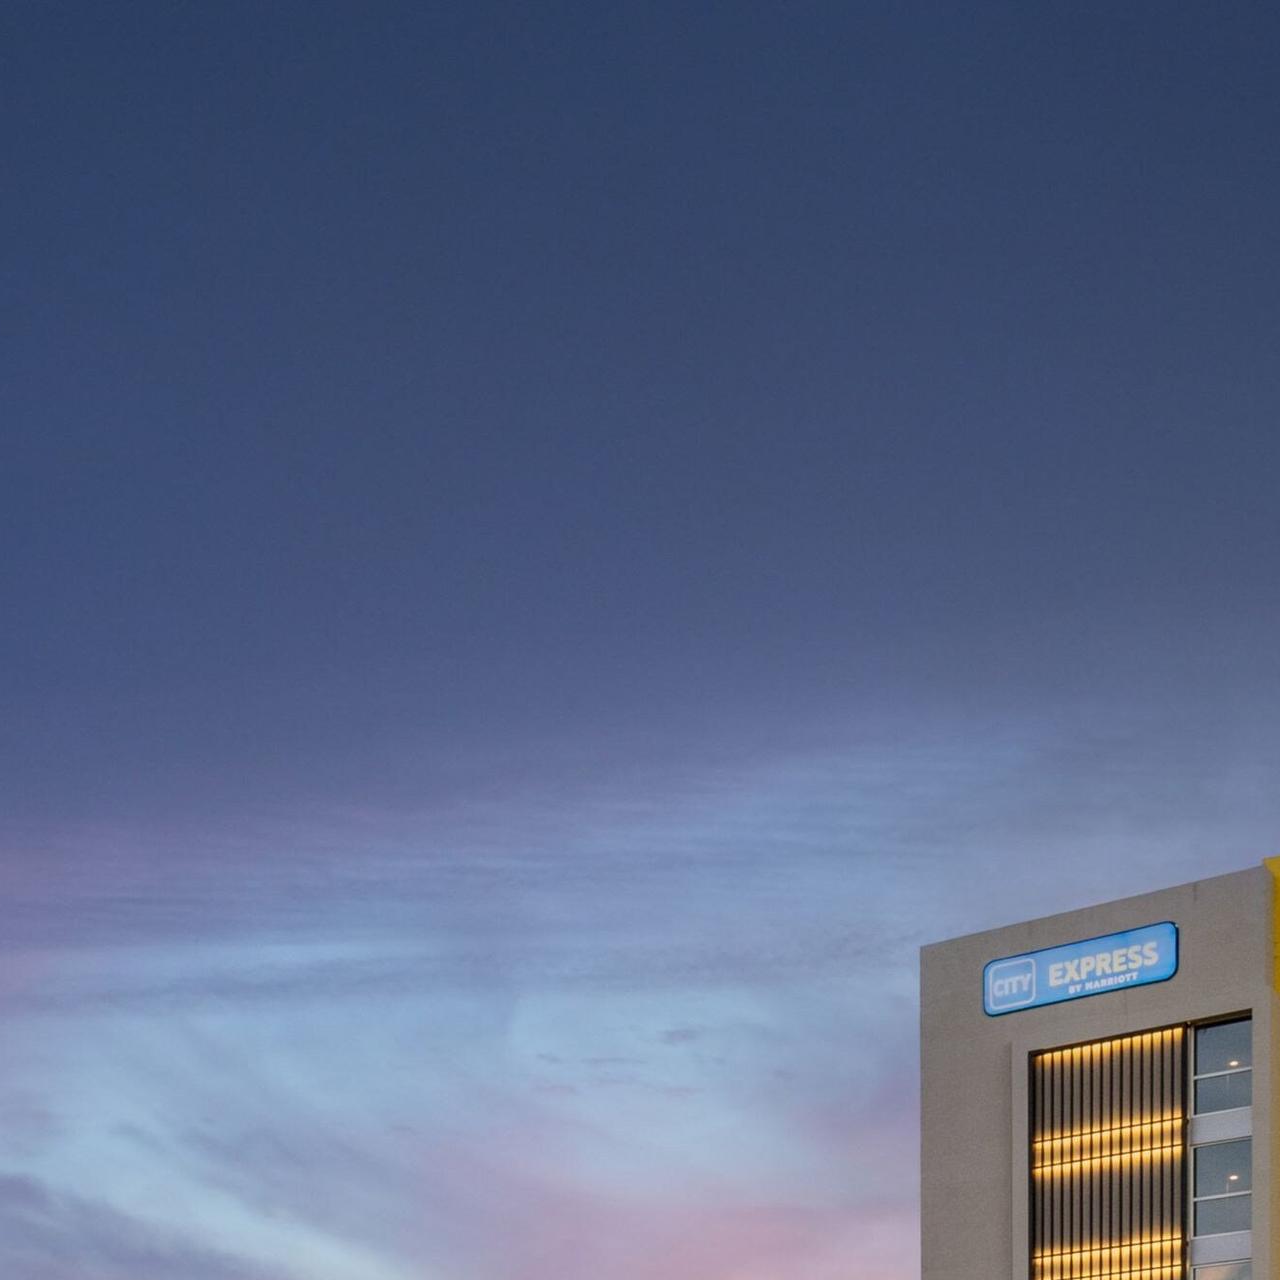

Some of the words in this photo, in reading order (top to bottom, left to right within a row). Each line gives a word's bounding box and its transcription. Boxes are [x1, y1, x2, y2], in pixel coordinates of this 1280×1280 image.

[992, 973, 1033, 998] CITY
[1048, 941, 1160, 988] EXPRESS
[1067, 983, 1083, 995] BY
[1084, 971, 1139, 991] MARRIOTT
